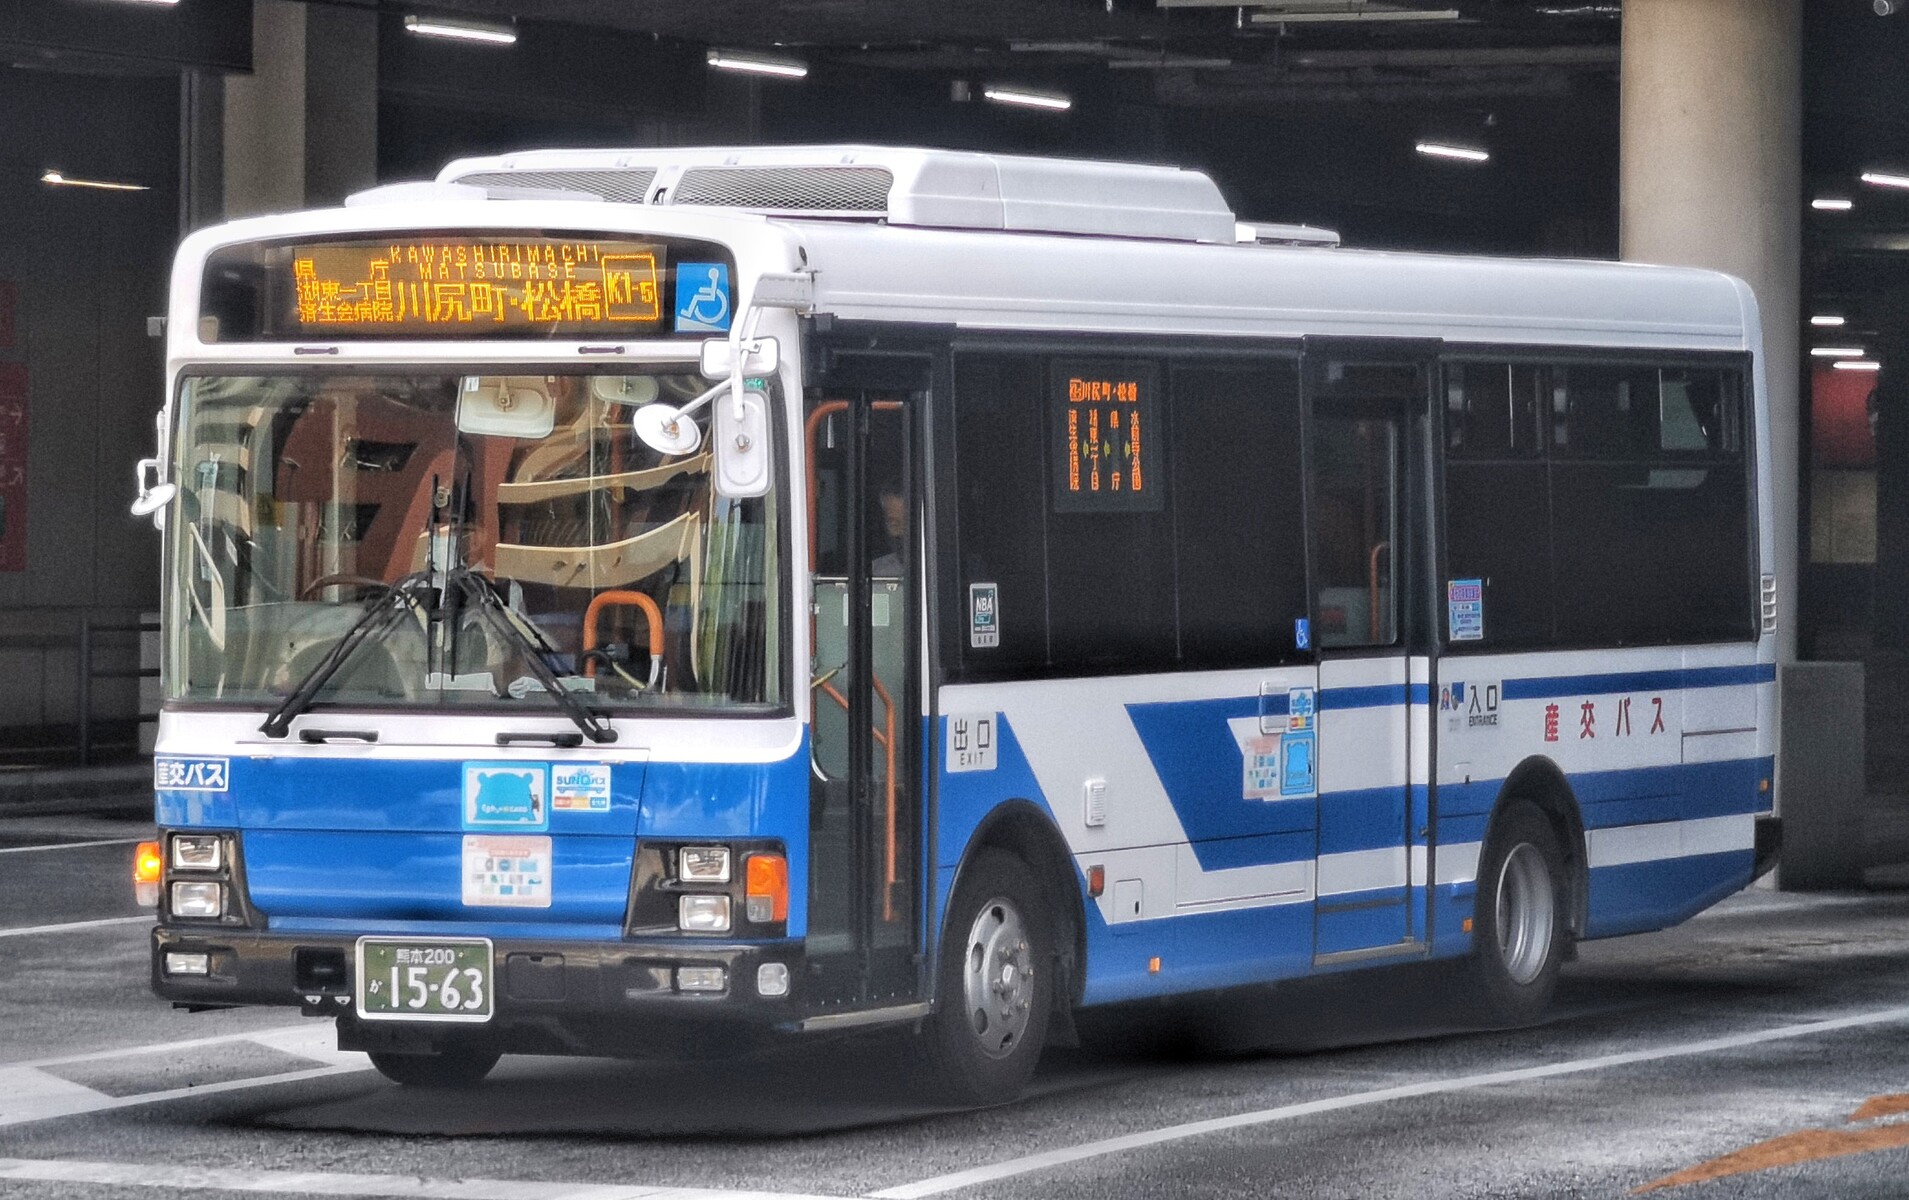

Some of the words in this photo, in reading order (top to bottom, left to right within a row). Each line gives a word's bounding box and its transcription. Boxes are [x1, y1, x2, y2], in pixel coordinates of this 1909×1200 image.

[390, 244, 600, 263] KAWASHIRIMACHI
[420, 262, 577, 280] MATSUBASE
[1468, 684, 1498, 714] 入口
[1468, 713, 1498, 727] ENTRANCE
[1544, 696, 1665, 742] 産交バス
[954, 718, 990, 750] 出口
[960, 753, 984, 765] EXIT
[391, 966, 483, 1009] 15-63
